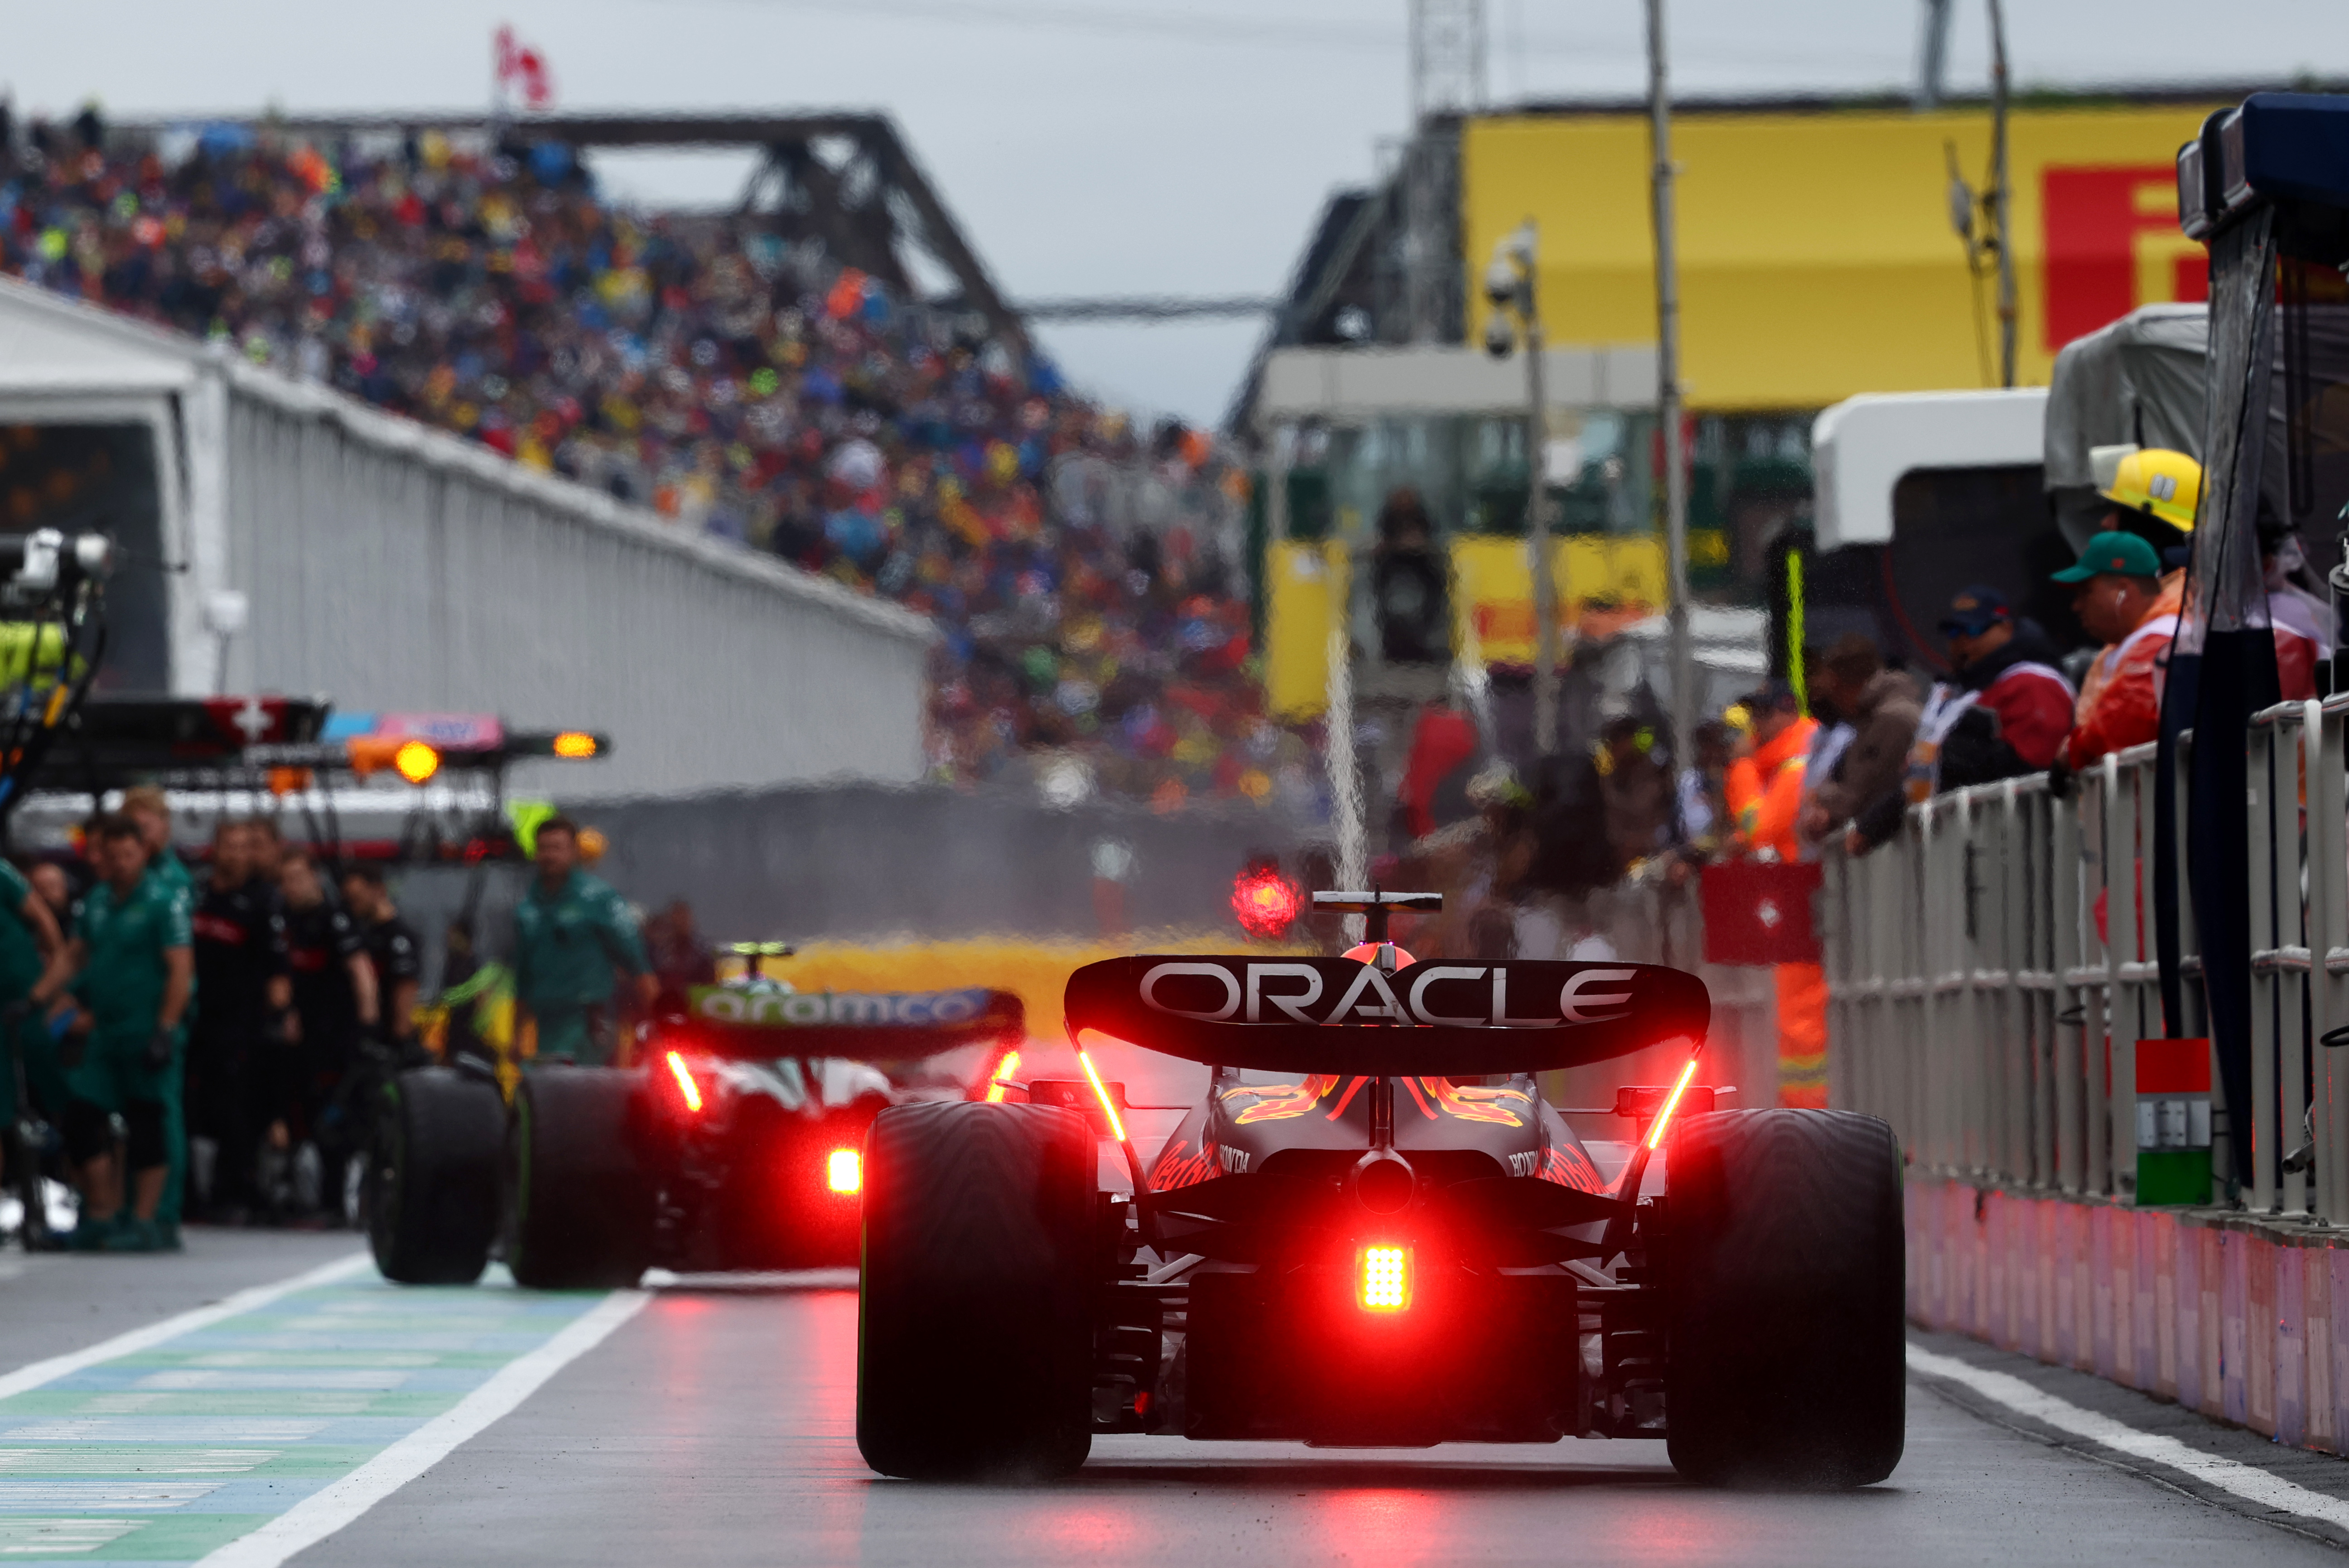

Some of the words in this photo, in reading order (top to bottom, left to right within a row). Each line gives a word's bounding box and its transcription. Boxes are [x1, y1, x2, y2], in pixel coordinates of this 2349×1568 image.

[700, 992, 975, 1025] aramco
[1139, 963, 1637, 1026] ORACLE
[1220, 1144, 1250, 1173] HONDA
